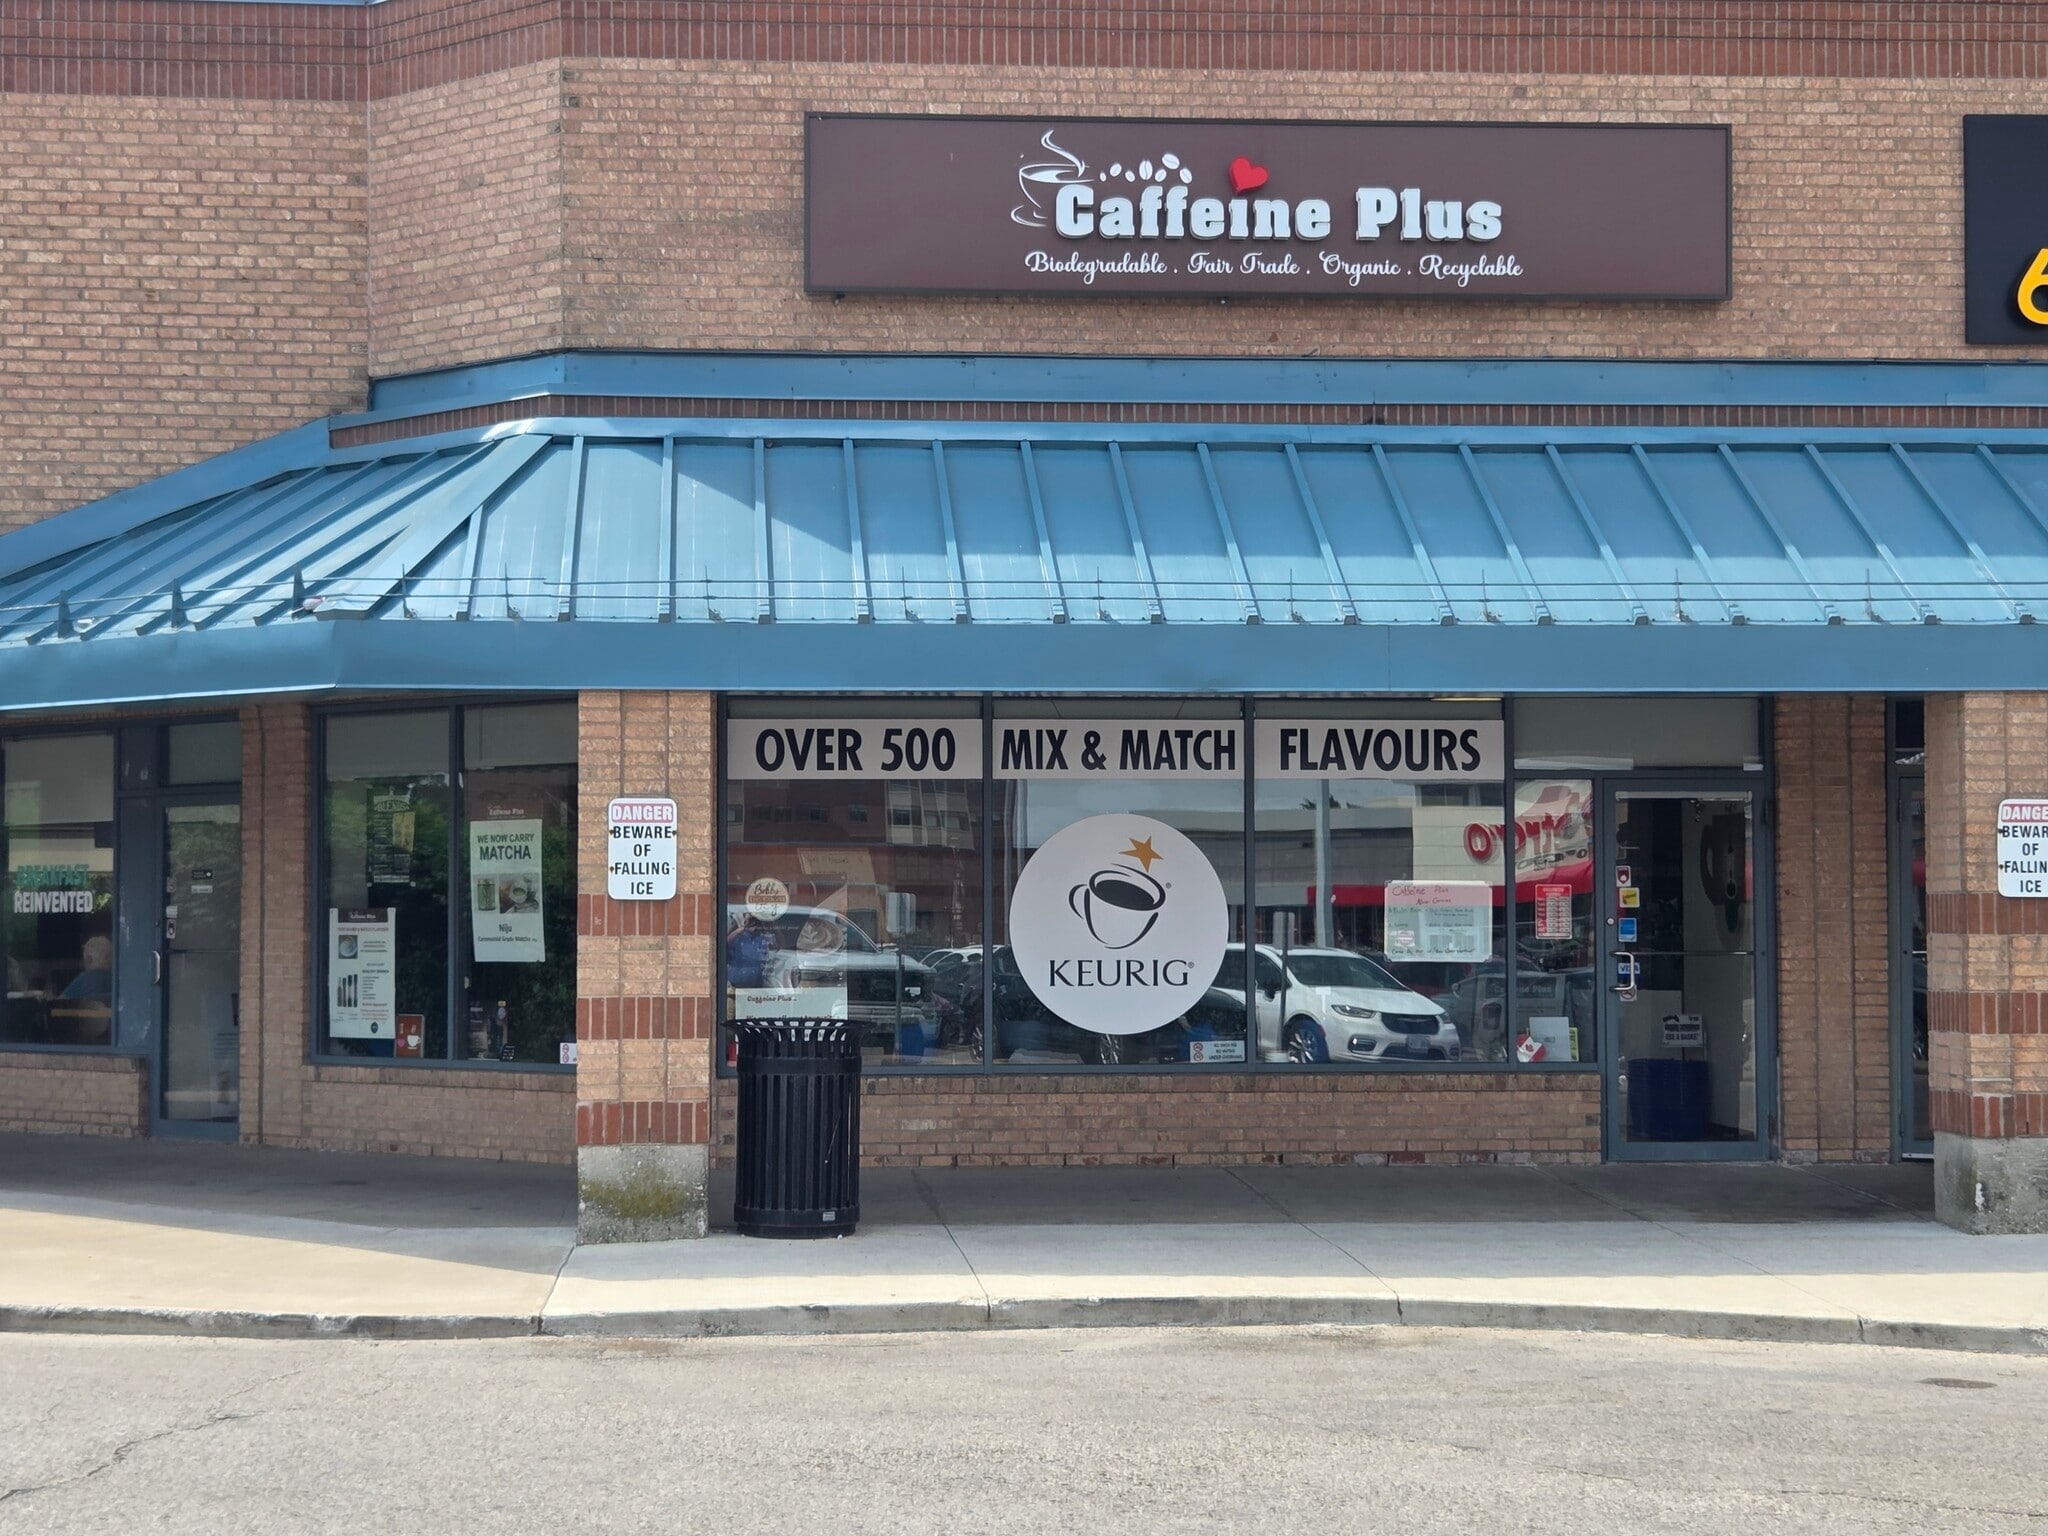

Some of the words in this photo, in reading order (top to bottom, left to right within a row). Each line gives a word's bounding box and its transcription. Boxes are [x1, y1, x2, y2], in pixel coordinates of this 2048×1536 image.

[1055, 184, 1331, 241] Caffeine
[1356, 187, 1503, 241] Plus
[1024, 249, 1168, 284] Biodegradable
[1188, 250, 1235, 276] Fair
[1242, 250, 1300, 276] Trade
[1319, 250, 1402, 287] Organic
[1418, 250, 1524, 287] Recyclable
[755, 728, 863, 771] OVER
[880, 727, 956, 772] 500
[1002, 728, 1068, 771] MIX
[1080, 728, 1106, 771] &
[1120, 728, 1235, 771] MATCH
[1280, 728, 1481, 771] FLAVOURS
[611, 804, 674, 821] DANGER
[2002, 806, 2048, 820] DANGE
[477, 835, 489, 844] WE
[490, 834, 508, 843] NOW
[509, 833, 535, 842] CARRY
[612, 826, 672, 840] BEWARE
[2002, 826, 2048, 838] BEWAR
[479, 844, 532, 861] MATCHA
[633, 844, 651, 857] OF
[2022, 843, 2039, 856] OF
[614, 862, 670, 876] FALLING
[2004, 861, 2048, 874] FALLIN
[16, 864, 90, 887] BREAKFAST
[630, 881, 654, 895] ICE
[2020, 880, 2042, 893] ICE
[14, 891, 94, 913] REINVENTED
